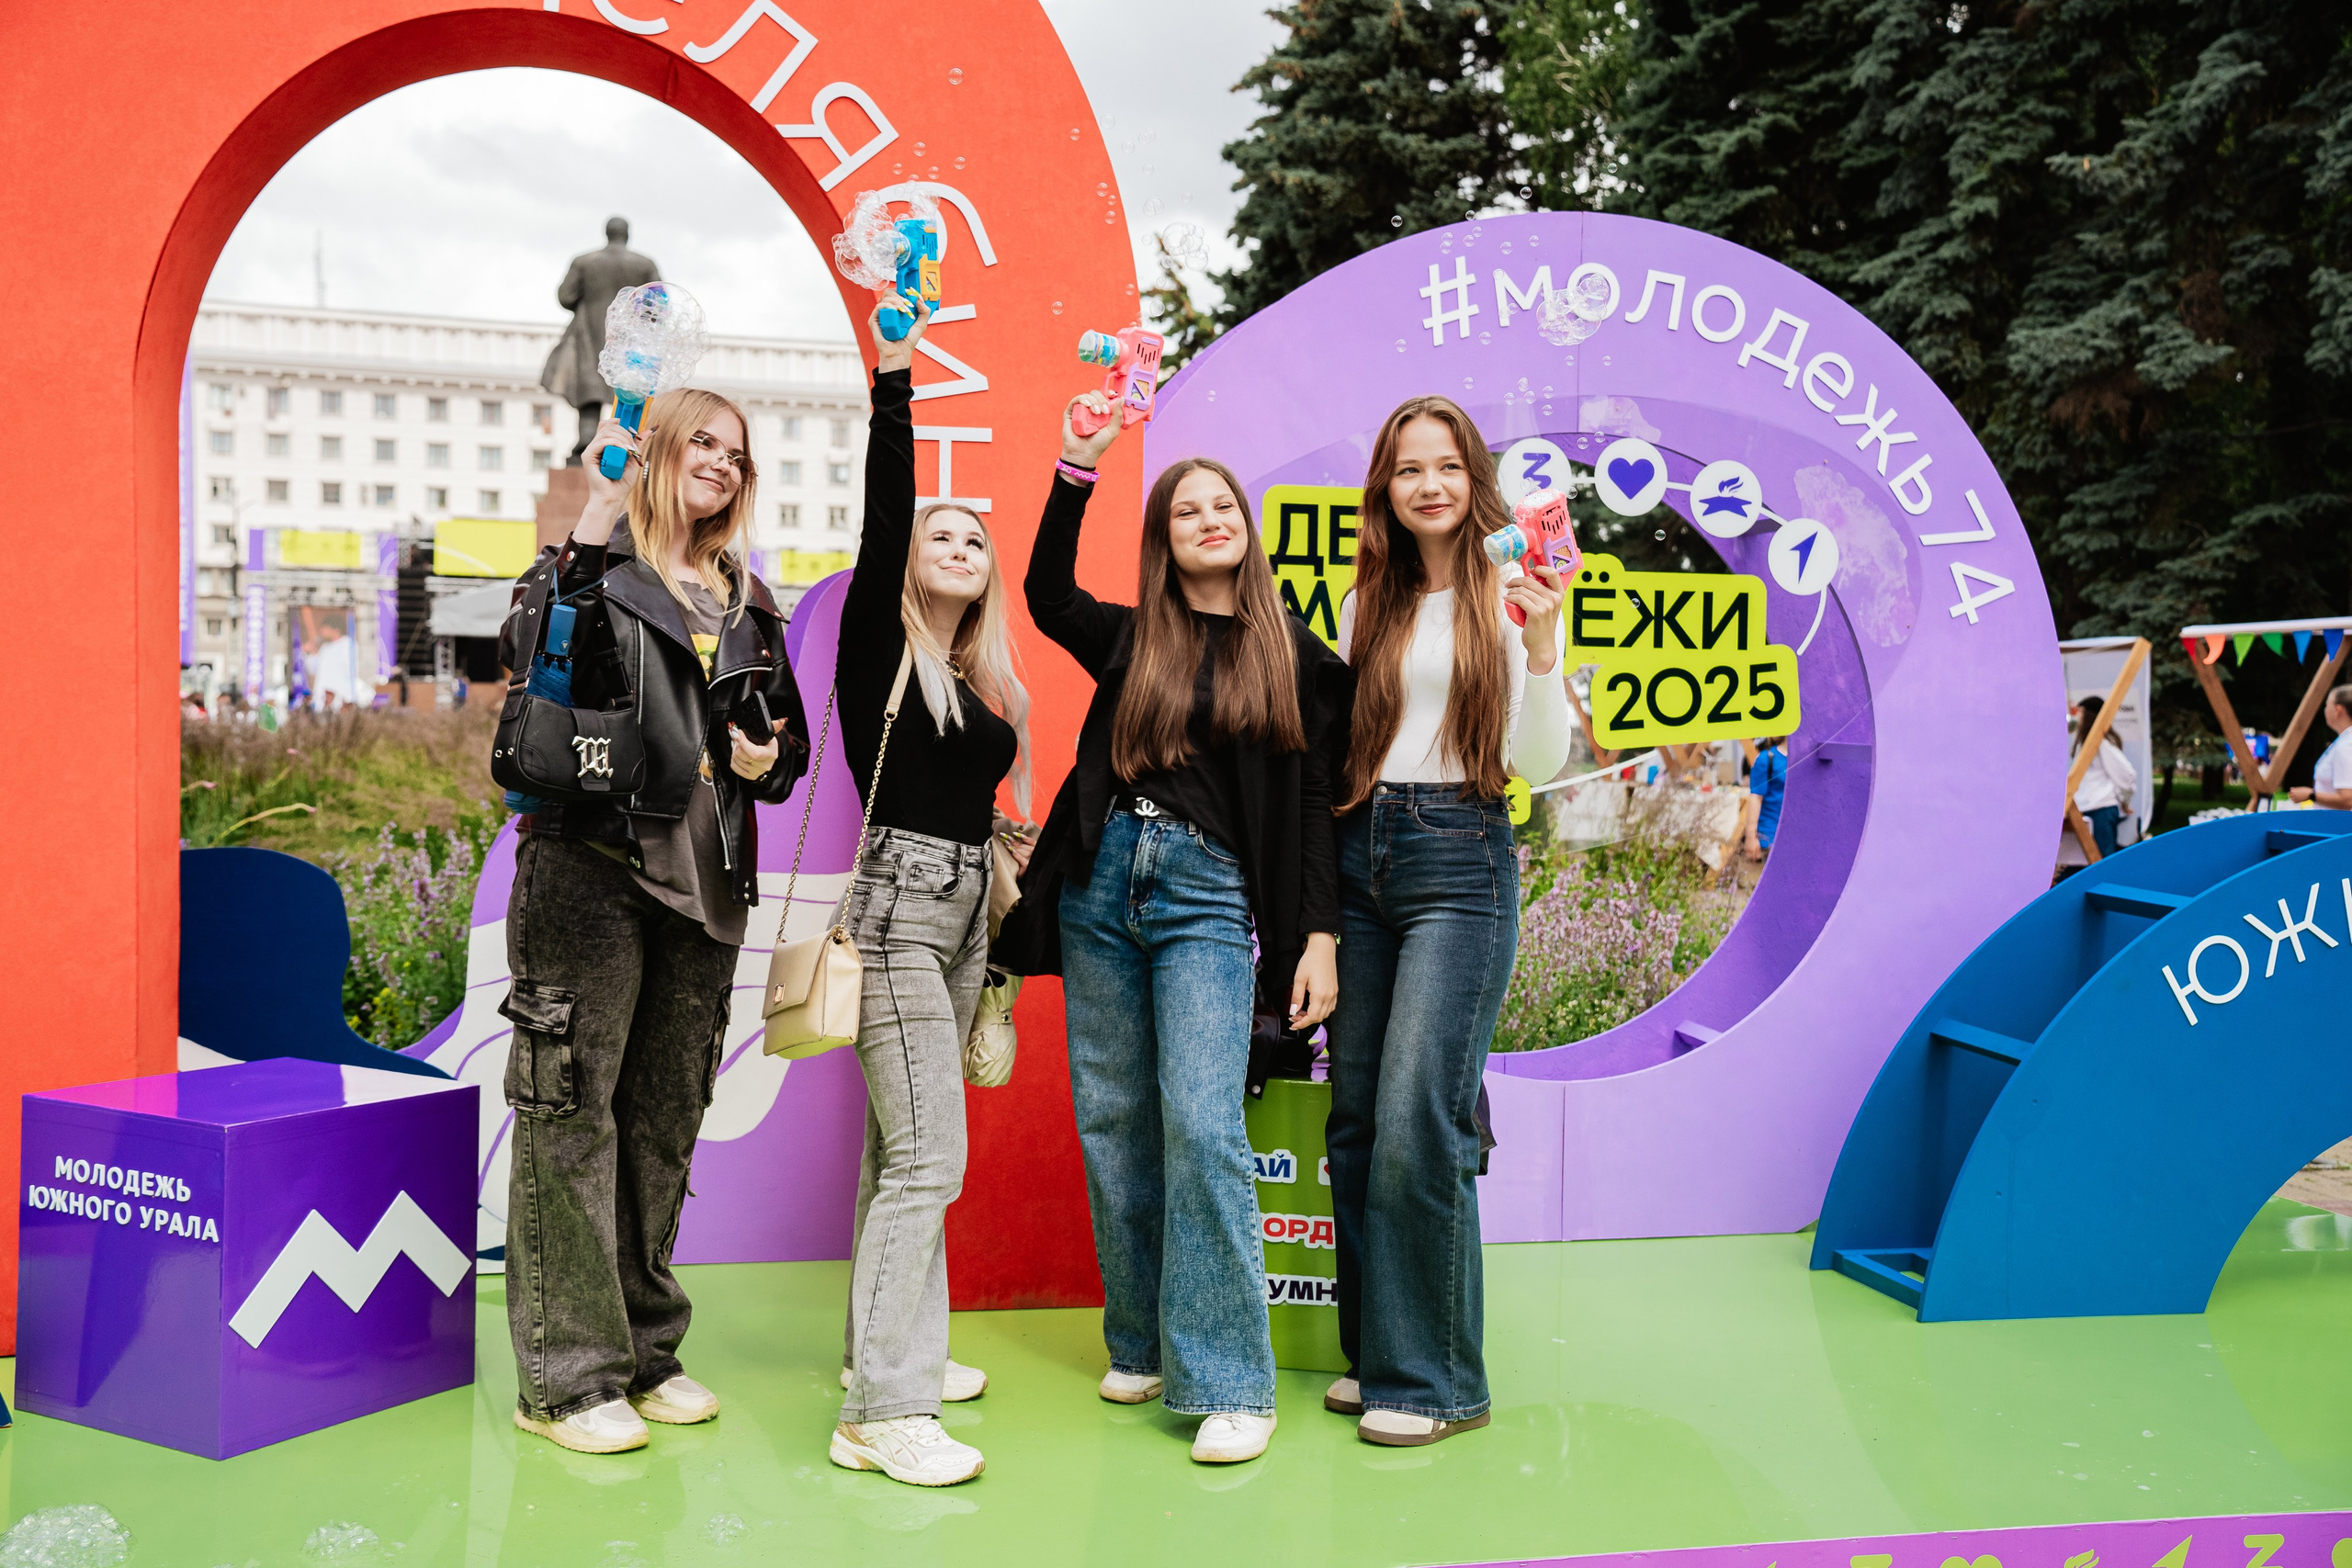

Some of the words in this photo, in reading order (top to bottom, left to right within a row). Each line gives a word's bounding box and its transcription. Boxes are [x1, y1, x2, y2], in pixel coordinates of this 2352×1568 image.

[1269, 502, 1359, 577] ДЕ
[1606, 662, 1785, 732] 2025
[54, 1155, 191, 1202] МОЛОДЕЖЬ
[1253, 1153, 1291, 1179] АЙ
[28, 1184, 132, 1225] ЮЖНОГО
[139, 1205, 220, 1243] УРАЛА
[1261, 1217, 1334, 1245] ОРД
[1267, 1278, 1339, 1303] УМН
